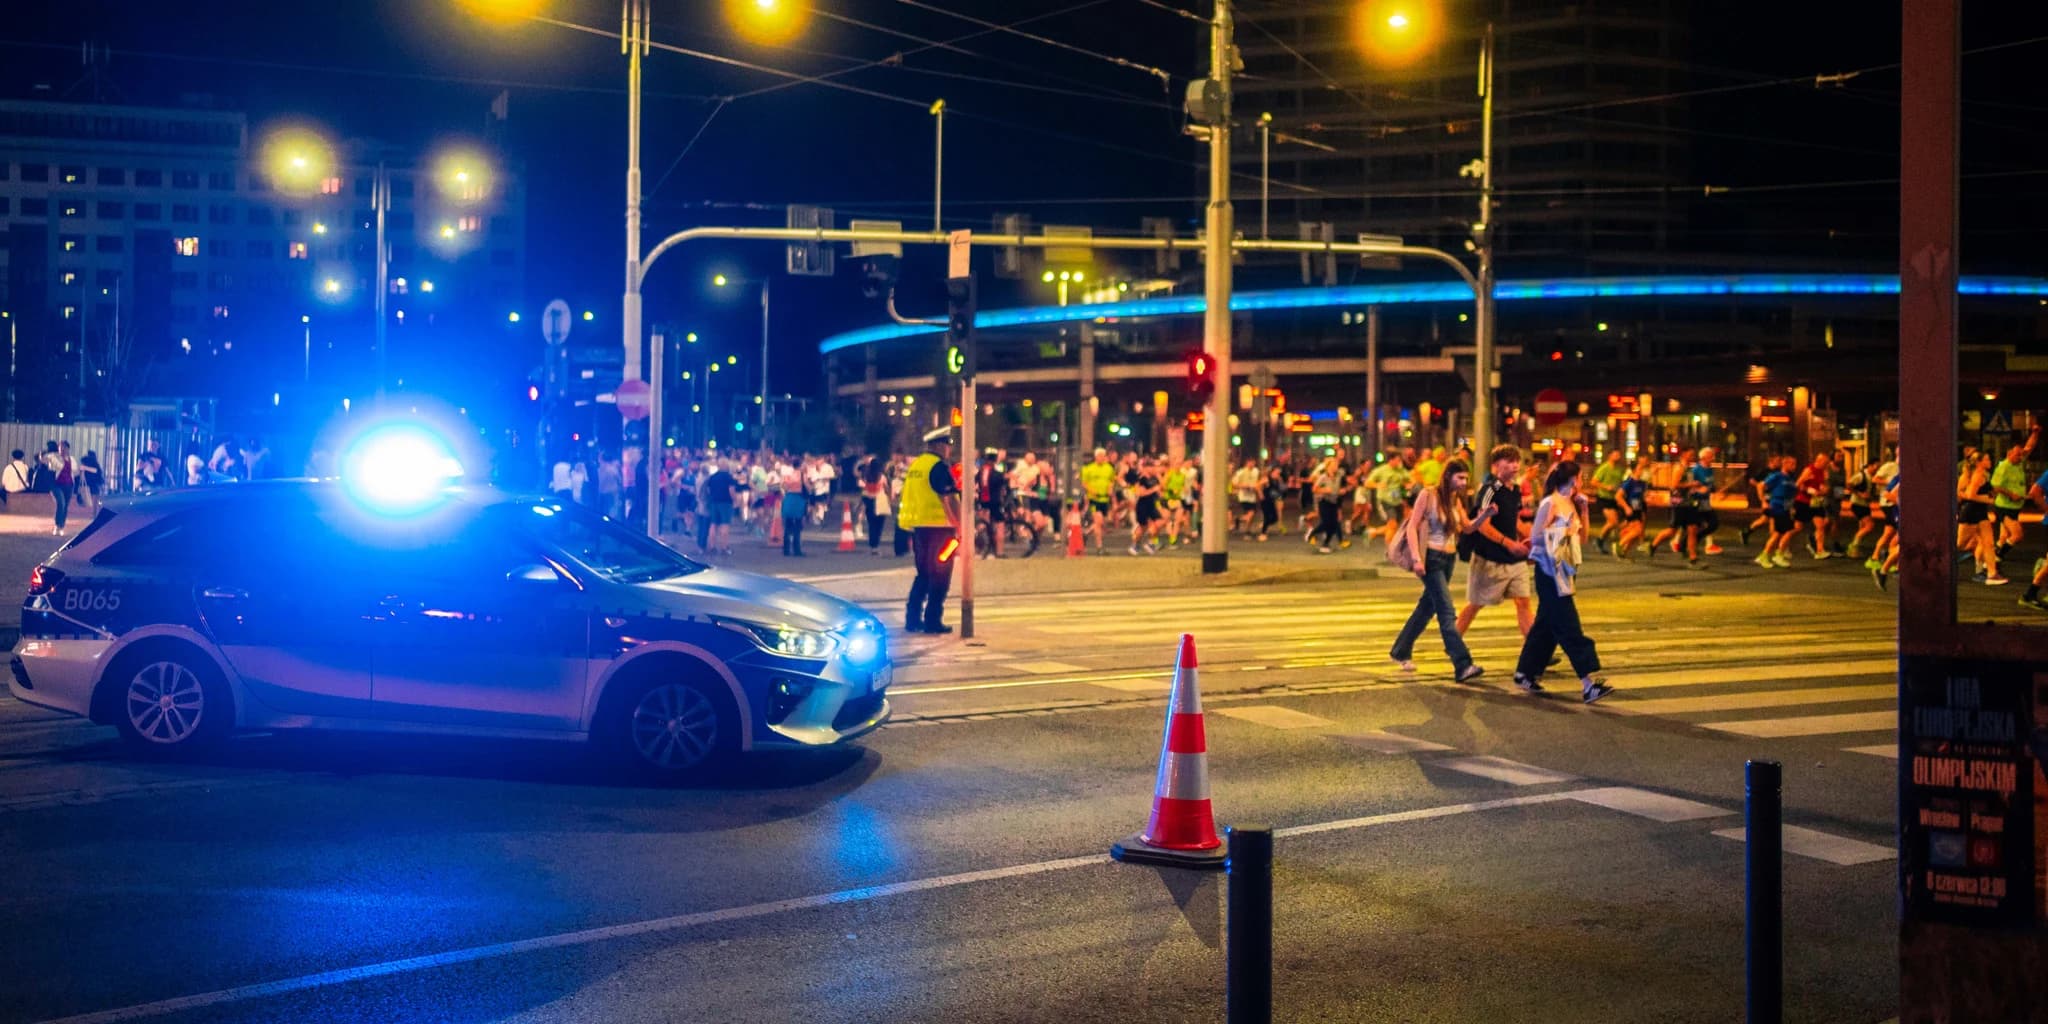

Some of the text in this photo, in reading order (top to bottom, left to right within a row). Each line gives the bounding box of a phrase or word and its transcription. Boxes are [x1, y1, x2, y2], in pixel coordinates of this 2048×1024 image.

[64, 588, 121, 610] B065
[1913, 755, 2016, 791] OLIMPIJSKIM
[1935, 874, 1979, 895] czerwca
